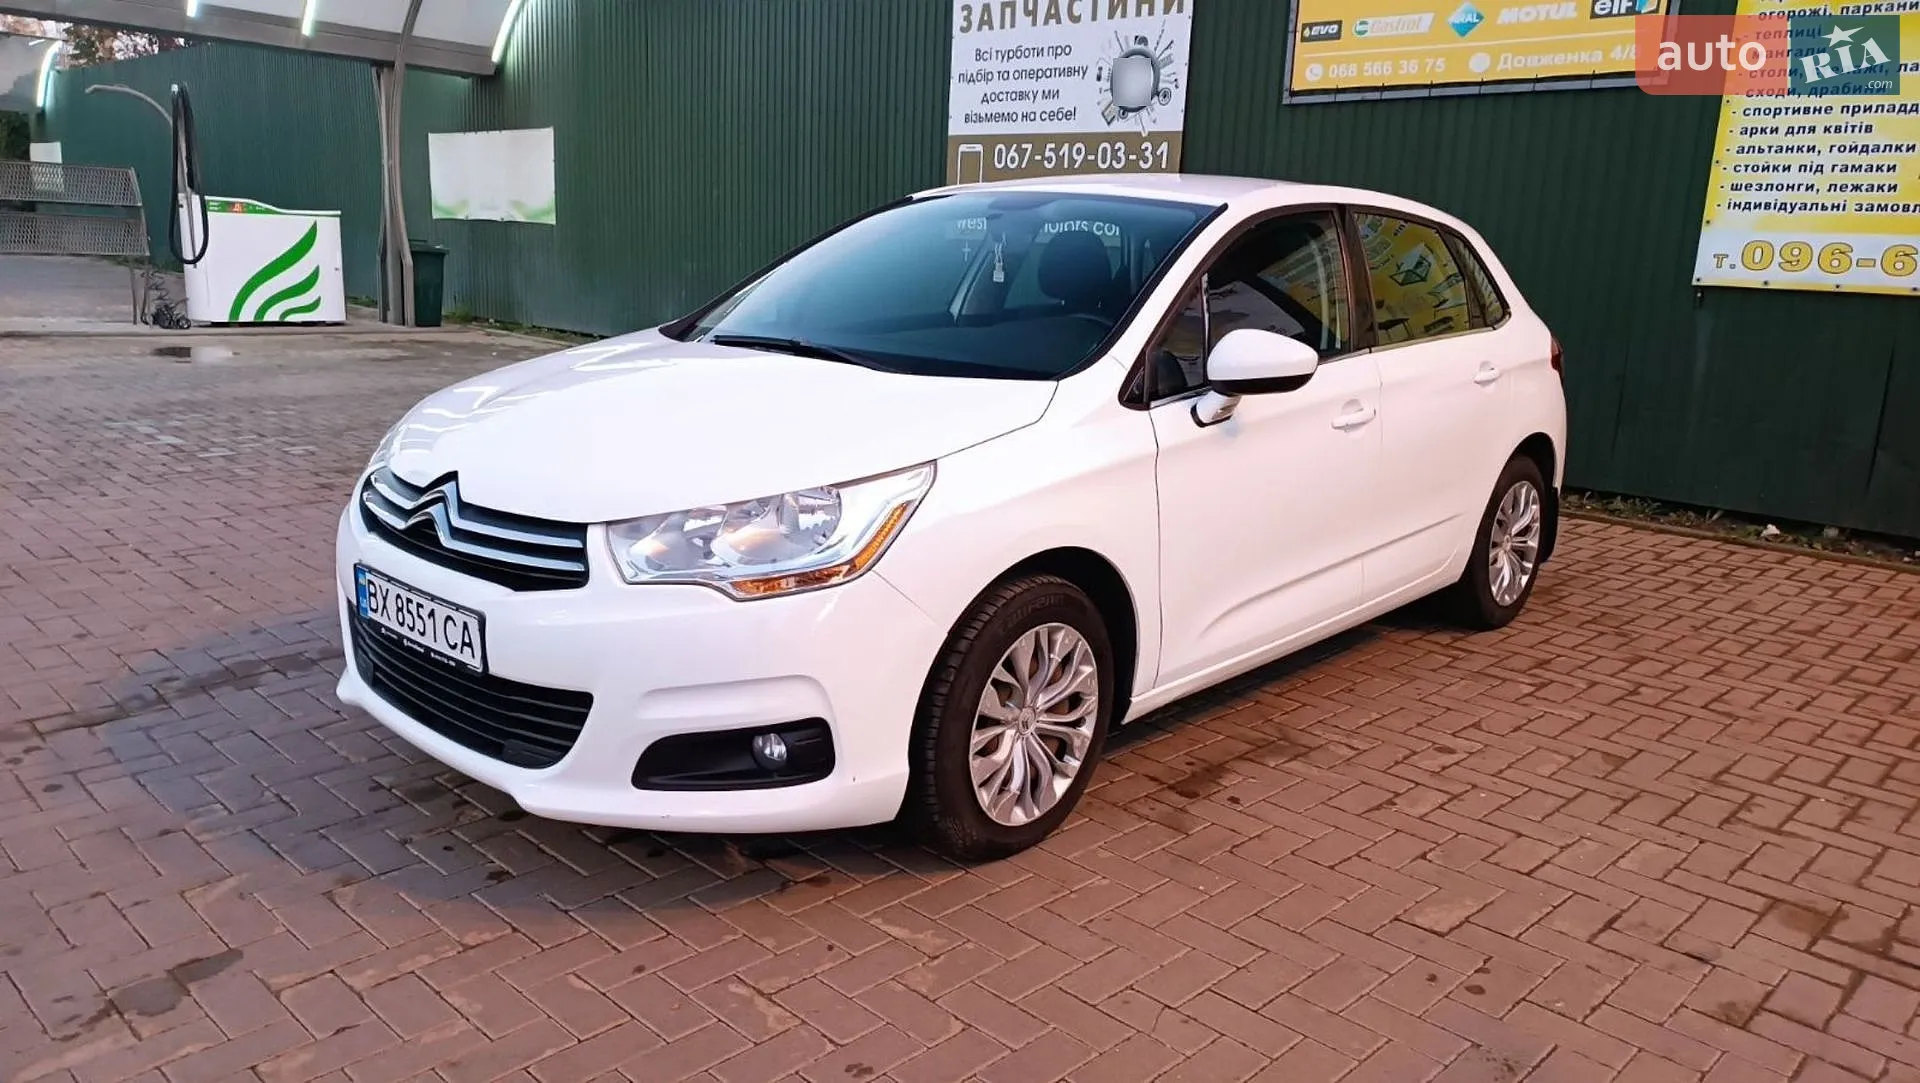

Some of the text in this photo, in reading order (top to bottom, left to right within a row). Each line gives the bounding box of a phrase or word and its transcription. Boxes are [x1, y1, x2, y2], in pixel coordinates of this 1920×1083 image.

[1840, 1, 1920, 18] паркани
[1311, 24, 1338, 36] EVO
[1497, 2, 1577, 25] MOTUL
[975, 43, 1073, 64] Всі турботи про
[958, 64, 1088, 85] підбір та оперативну
[1398, 59, 1419, 75] 36
[1423, 57, 1446, 73] 75
[981, 88, 1060, 105] доставку ми
[964, 107, 1077, 125] візьмемо на себе!
[1743, 102, 1920, 119] спортивне приладд
[1739, 121, 1874, 138] арки для квітів
[994, 141, 1169, 170] 067-519-03-31
[1736, 141, 1916, 156] альтанки, гойдалки
[1733, 161, 1897, 175] стойки під гамаки
[1730, 181, 1898, 195] шезлонги, лежаки
[1727, 198, 1847, 214] індивідуальні
[367, 578, 475, 659] BX 8551 CA
